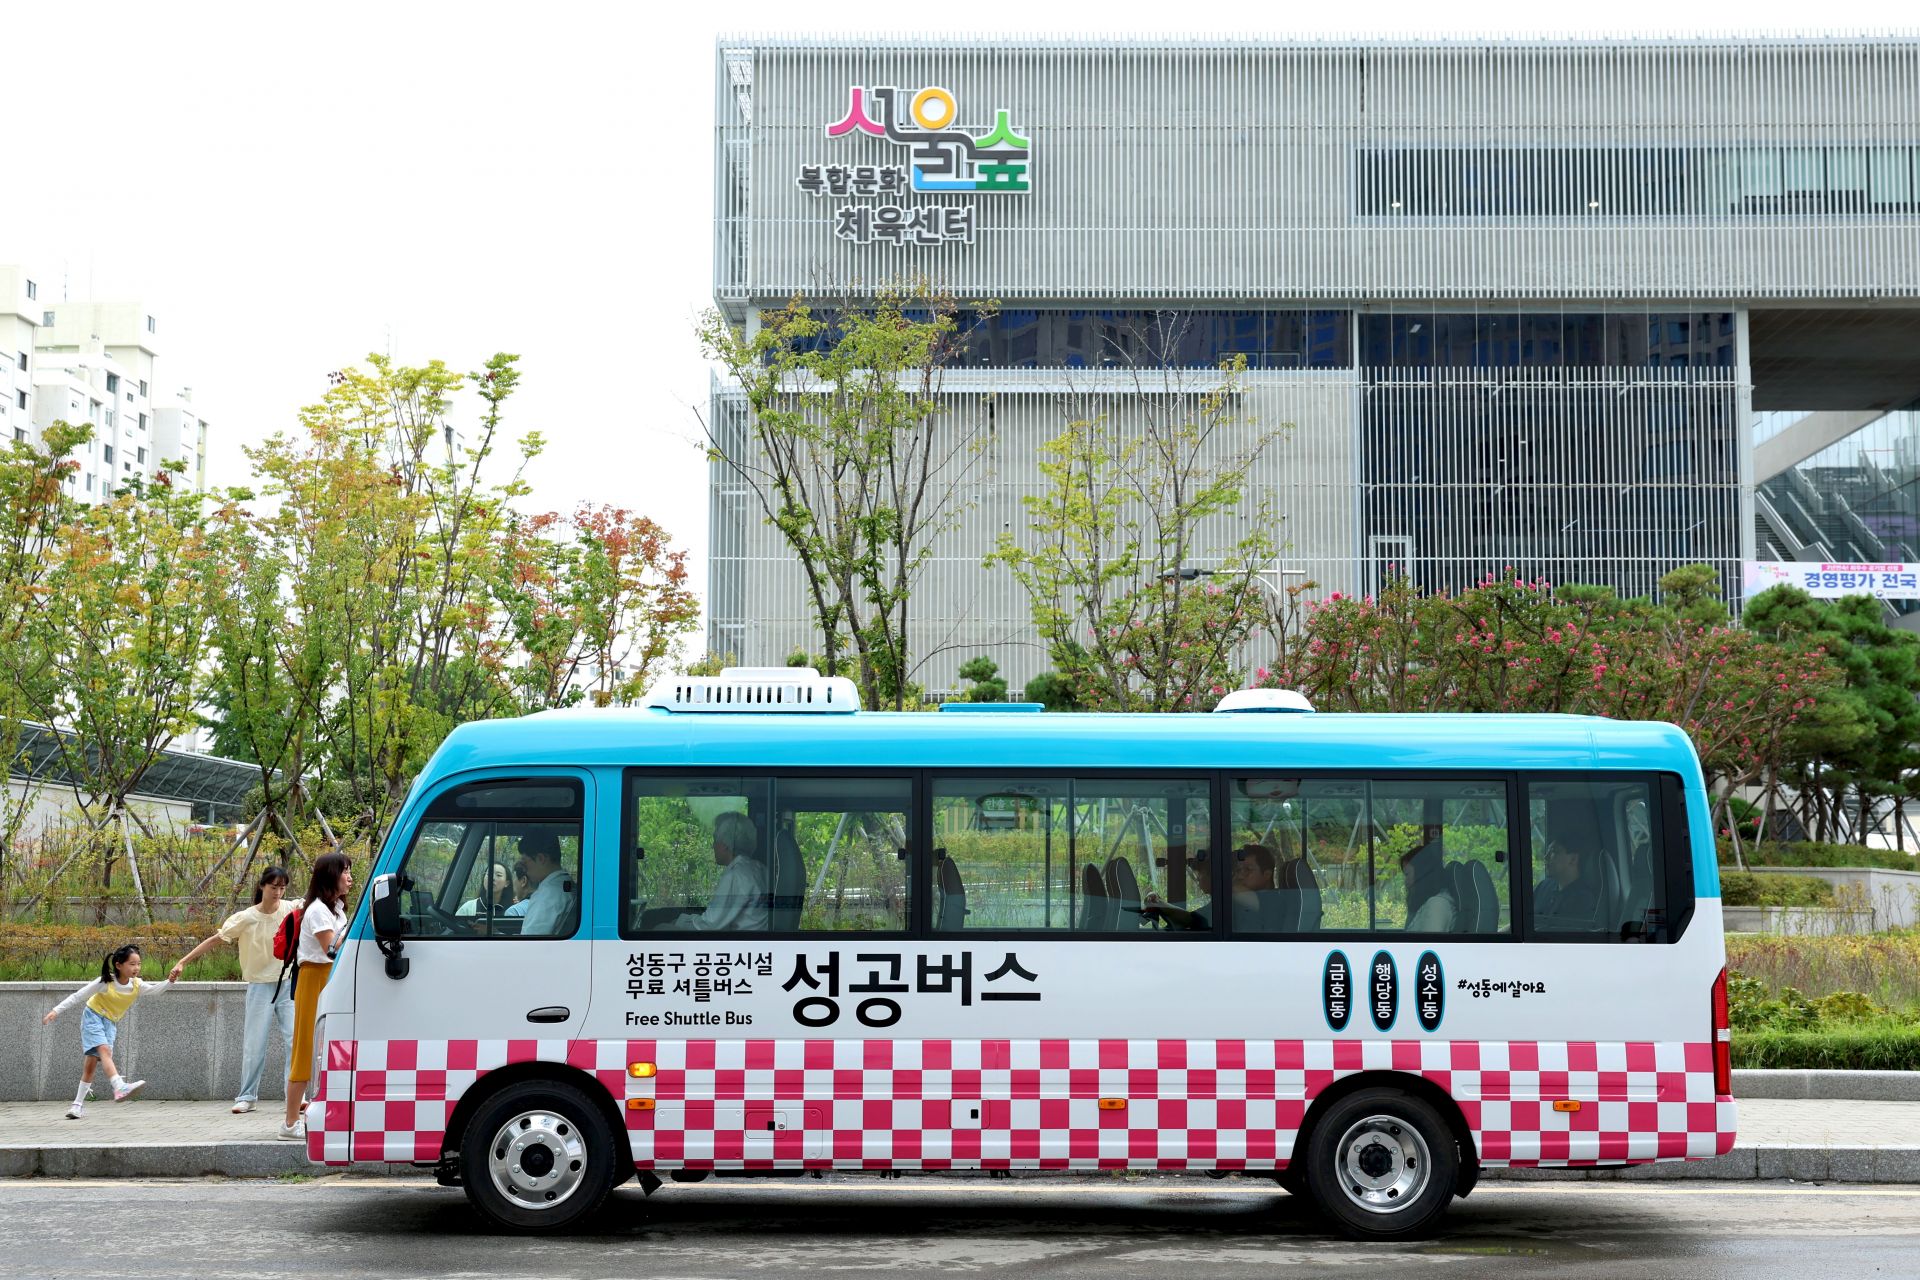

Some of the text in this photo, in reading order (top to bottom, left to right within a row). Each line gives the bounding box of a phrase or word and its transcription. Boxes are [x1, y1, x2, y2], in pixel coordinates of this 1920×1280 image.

[828, 87, 1029, 191] 서울숲
[797, 165, 907, 195] 복합문화
[837, 206, 974, 244] 체육센터
[1804, 572, 1917, 588] 경영평가 전국
[626, 952, 772, 977] 성동구 공공시설
[626, 979, 752, 1002] 무료 셔틀버스
[782, 951, 1041, 1027] 성공버스
[1329, 963, 1346, 1018] 금호동
[1375, 963, 1392, 1019] 행당동
[1422, 963, 1439, 1019] 성수동
[626, 1011, 752, 1025] Free Shuttle Bus
